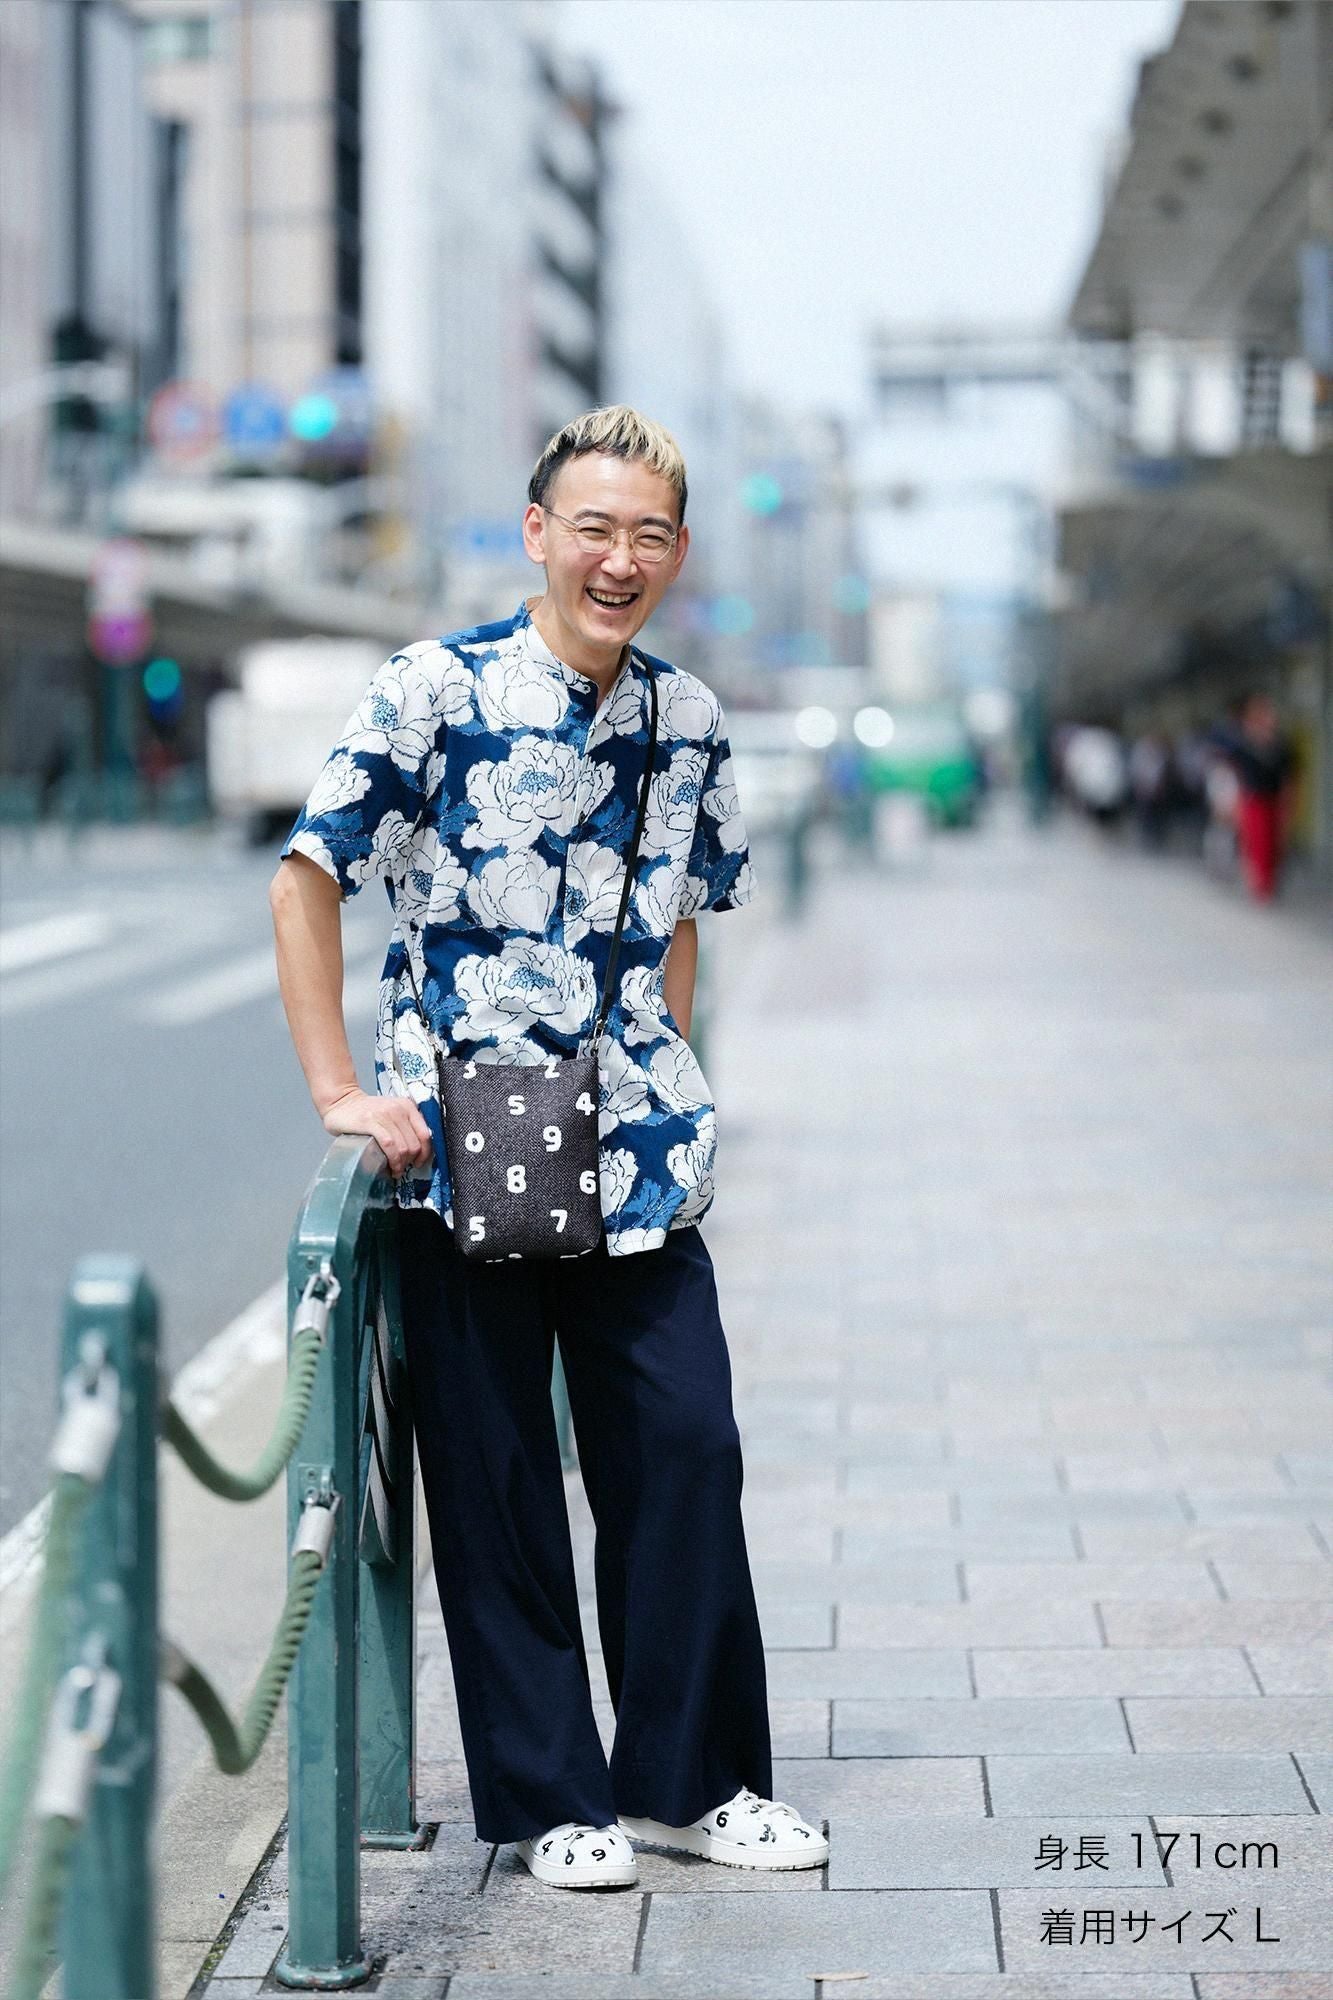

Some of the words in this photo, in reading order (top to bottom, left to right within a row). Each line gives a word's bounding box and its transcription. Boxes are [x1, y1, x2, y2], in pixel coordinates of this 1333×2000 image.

[508, 1094, 526, 1116] 5
[575, 1092, 596, 1116] 4
[543, 1125, 562, 1152] 9
[506, 1164, 527, 1194] 8
[579, 1170, 597, 1195] 6
[469, 1215, 486, 1241] 5
[550, 1209, 567, 1233] 7
[716, 1810, 730, 1829] 6
[541, 1840, 554, 1856] 4
[591, 1848, 607, 1862] 9
